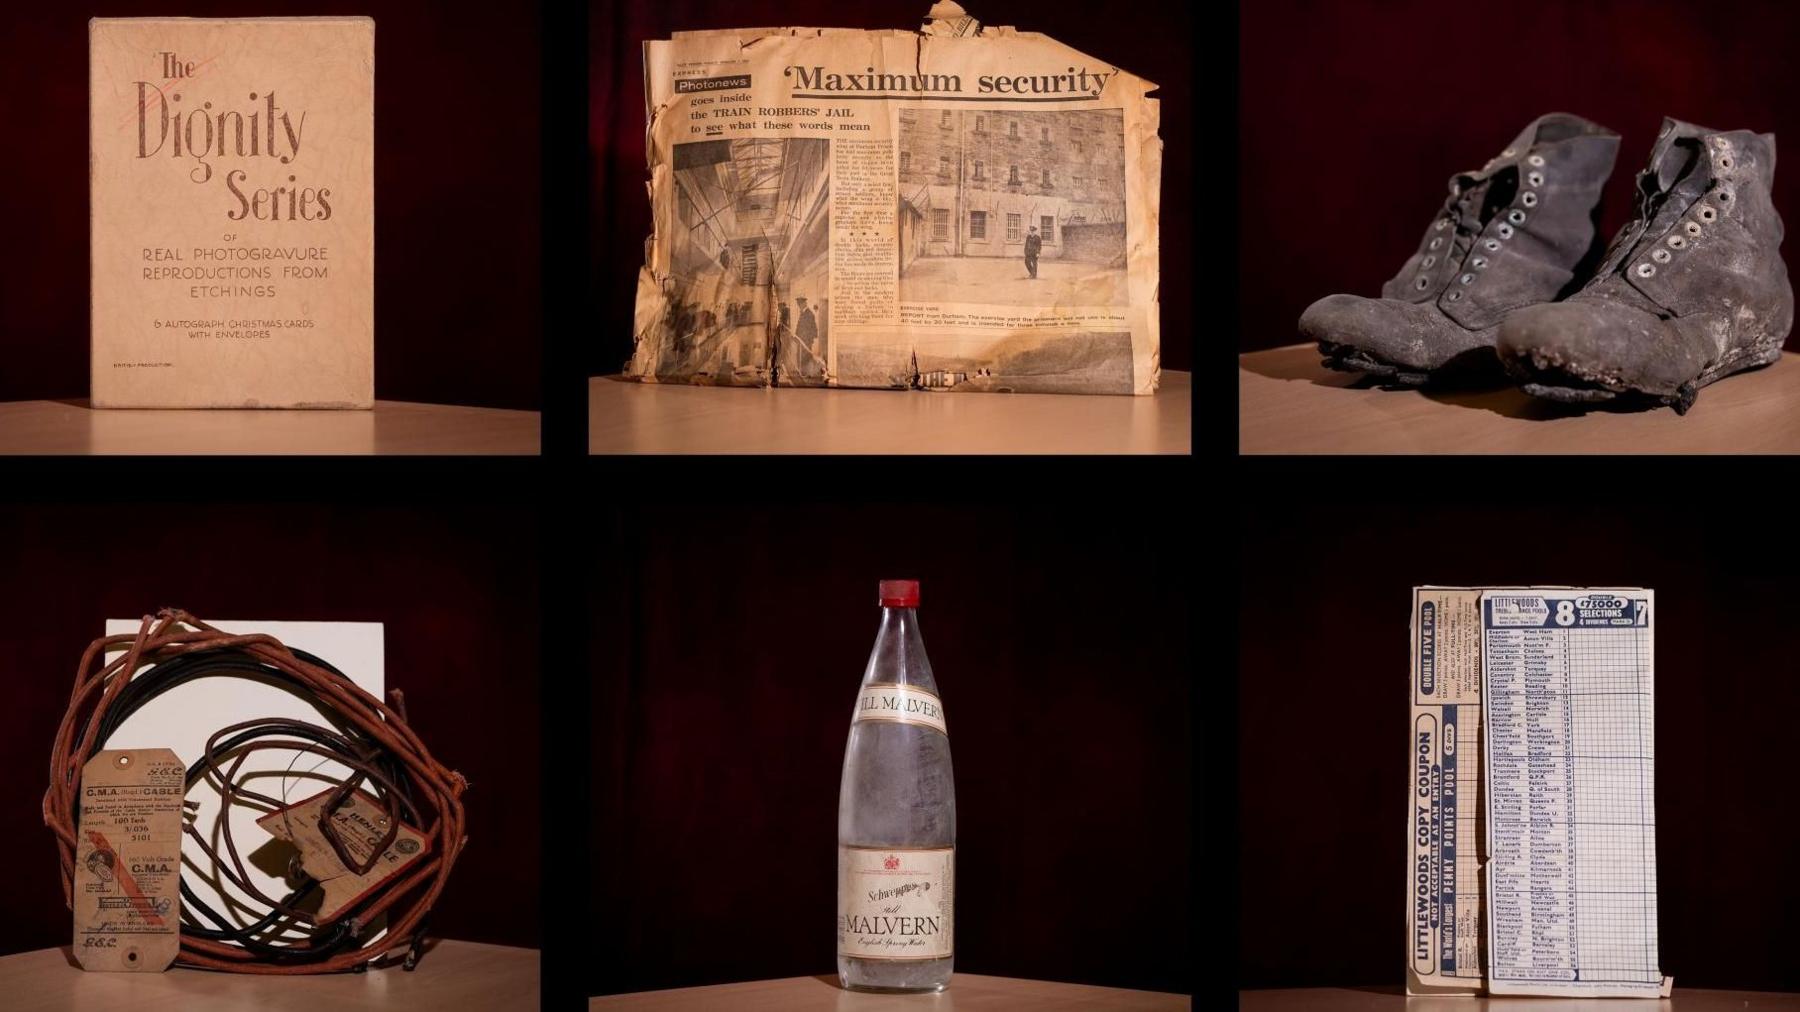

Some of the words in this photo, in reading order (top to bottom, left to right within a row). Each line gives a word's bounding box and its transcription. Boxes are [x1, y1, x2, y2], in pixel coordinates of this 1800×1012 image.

[159, 52, 195, 79] The
[680, 78, 748, 90] Photonews
[690, 96, 715, 106] goes
[720, 94, 752, 104] inside
[690, 110, 708, 120] the
[713, 108, 752, 118] TRAIN
[758, 107, 820, 118] ROBBERS'
[825, 108, 854, 118] JAIL
[134, 81, 306, 183] Dignity
[690, 124, 701, 134] to
[706, 123, 724, 132] see
[729, 122, 757, 131] what
[763, 121, 793, 130] these
[800, 122, 834, 130] words
[839, 123, 871, 131] mean
[226, 169, 332, 221] Series
[223, 233, 238, 242] OF
[142, 248, 183, 262] REAL
[194, 248, 328, 261] PHOTOGRAVURE
[143, 266, 272, 280] REPRODUCTIONS
[283, 266, 328, 280] FROM
[190, 286, 276, 298] ETCHINGS
[165, 320, 224, 328] AUTOGRAPH
[228, 320, 282, 328] CHRISTMAS
[284, 320, 314, 328] CARDS
[188, 331, 210, 339] WITH
[216, 330, 270, 338] ENVELOPES
[1555, 601, 1575, 626] 8
[1581, 601, 1622, 609] £75000
[1636, 601, 1648, 626] 7
[1424, 608, 1432, 625] POOL
[1423, 629, 1432, 654] FIVE
[1423, 658, 1432, 687] DOUBLE
[1418, 732, 1430, 798] COUPON
[1444, 768, 1454, 795] POOL
[1432, 806, 1438, 820] AN
[1418, 806, 1429, 847] COPY
[1432, 824, 1438, 835] AS
[1444, 807, 1454, 847] POINTS
[132, 864, 171, 873] C.M.A.
[1444, 858, 1453, 893] PENNY
[1417, 854, 1429, 960] LITTLEWOODS
[1443, 903, 1453, 925] Largest
[846, 914, 940, 936] MALVERN
[1443, 927, 1453, 948] World's
[1443, 950, 1453, 960] The
